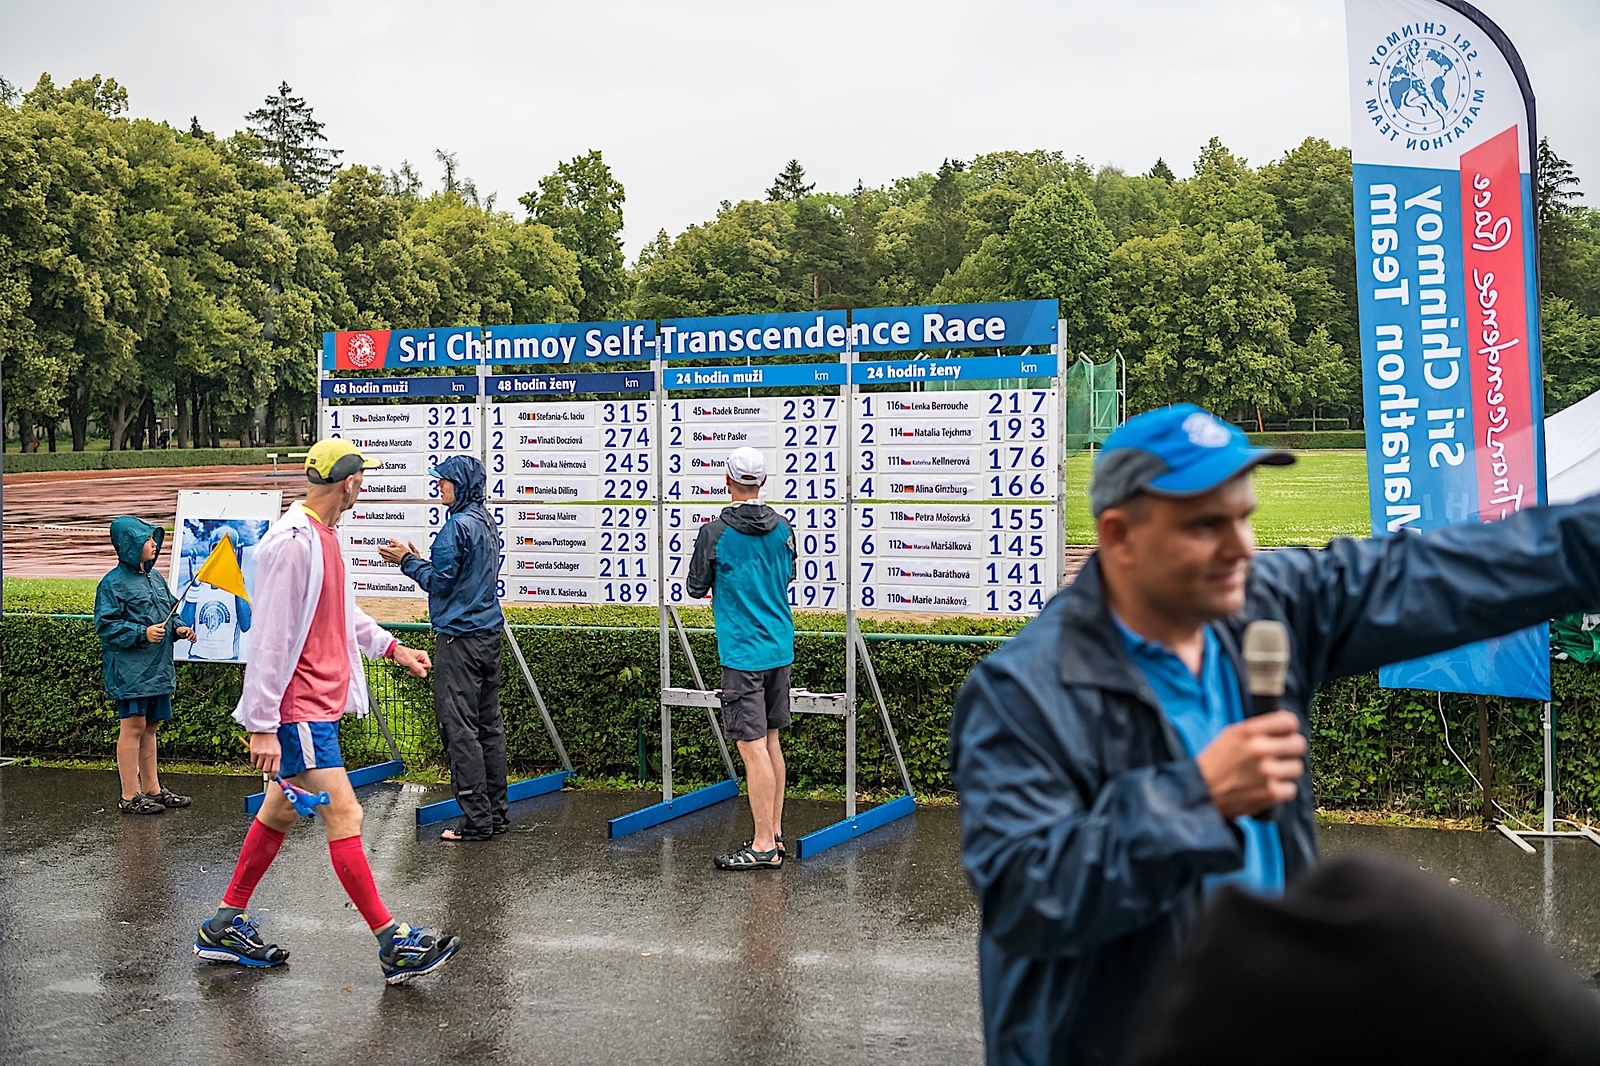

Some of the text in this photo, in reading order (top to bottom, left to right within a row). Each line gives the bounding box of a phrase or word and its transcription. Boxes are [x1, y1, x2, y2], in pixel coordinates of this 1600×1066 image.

[399, 333, 436, 362] Sri
[447, 328, 575, 364] Chinmoy
[923, 312, 1006, 342] Race
[676, 369, 829, 384] 24 hodin muži km
[867, 362, 1037, 379] 24 hodin ženy km
[333, 381, 465, 394] 48 hodin muži km
[497, 377, 639, 393] 48 hodin ženy km
[492, 406, 503, 425] 1
[518, 412, 527, 420] 40
[603, 403, 647, 423] 315
[671, 398, 836, 421] 1 45 Radek Brunner 237
[862, 392, 1046, 417] 1 116 Lenka Berrouche 217
[331, 411, 340, 428] 1
[352, 414, 359, 422] 19
[428, 406, 472, 425] 321
[390, 439, 412, 447] Marcato
[428, 430, 471, 450] 320
[492, 431, 503, 449] 2
[519, 436, 527, 444] 37
[537, 436, 555, 444] Vinati
[604, 427, 649, 448] 274
[670, 425, 836, 447] 2 86 Petr Pasler 227
[861, 423, 874, 444] 2
[890, 428, 903, 436] 114
[915, 428, 940, 437] Natalia
[988, 417, 1045, 440] 193
[493, 454, 504, 473] 3
[522, 460, 530, 468] 36
[605, 453, 649, 473] 245
[669, 452, 836, 473] 3 69 Ivan 221
[861, 447, 1045, 471] 3 111 Kellnerová 176
[368, 485, 386, 493] Daniel
[492, 479, 504, 497] 4
[535, 486, 557, 494] Daniela
[604, 479, 648, 499] 229
[669, 481, 681, 500] 4
[691, 486, 700, 494] 72
[710, 486, 726, 495] Josef
[784, 479, 836, 499] 215
[860, 474, 1045, 497] 4 120 Alina Ginzburg 166
[494, 507, 504, 526] 5
[518, 512, 526, 520] 33
[536, 512, 556, 520] Surasa
[601, 507, 647, 527] 229
[669, 509, 681, 528] 5
[692, 514, 700, 522] 67
[784, 508, 836, 529] 213
[861, 508, 874, 528] 5
[890, 511, 903, 521] 118
[915, 513, 934, 522] Petra
[990, 508, 1043, 530] 155
[516, 537, 524, 545] 35
[601, 532, 646, 552] 223
[669, 533, 681, 552] 6
[861, 534, 874, 555] 6
[889, 540, 901, 549] 112
[989, 534, 1043, 556] 145
[352, 558, 359, 566] 10
[517, 558, 646, 577] 30 Gerda Schlager 211
[669, 556, 682, 575] 7
[861, 563, 874, 583] 7
[888, 568, 900, 576] 117
[986, 562, 1042, 584] 141
[496, 580, 506, 598] 8
[519, 586, 527, 594] 29
[537, 588, 549, 596] Ewa
[551, 588, 557, 596] K.
[604, 583, 647, 602] 189
[670, 582, 835, 607] 8 197
[861, 586, 874, 607] 8
[887, 594, 900, 602] 110
[912, 595, 932, 604] Marie
[986, 589, 1044, 612] 134
